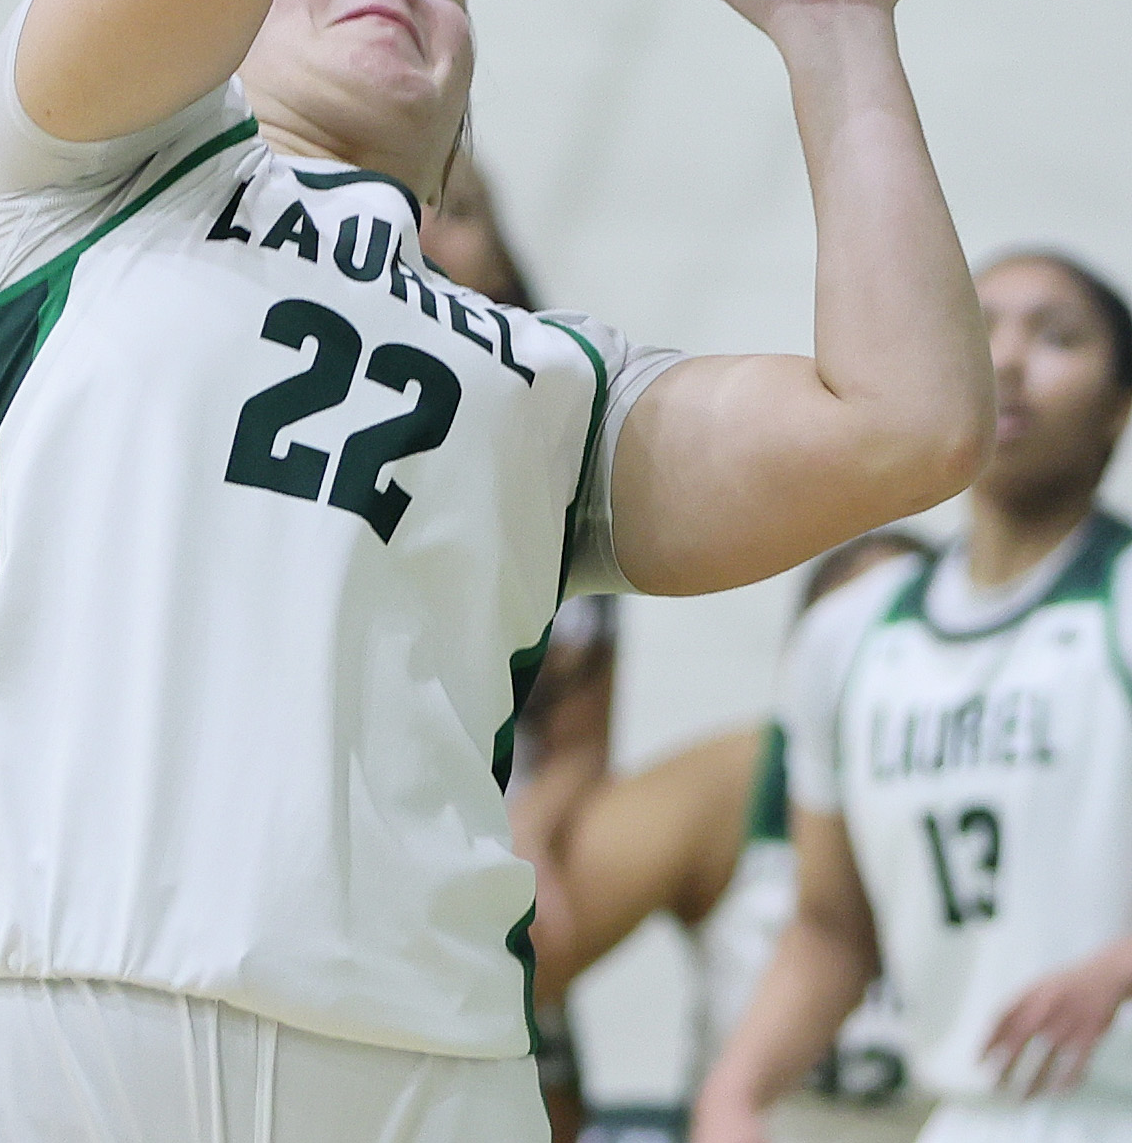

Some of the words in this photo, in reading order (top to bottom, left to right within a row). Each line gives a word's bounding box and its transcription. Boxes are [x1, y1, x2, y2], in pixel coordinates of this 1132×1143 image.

[205, 174, 536, 389] LAUREL
[224, 298, 462, 546] 22
[922, 805, 1004, 925] 13
